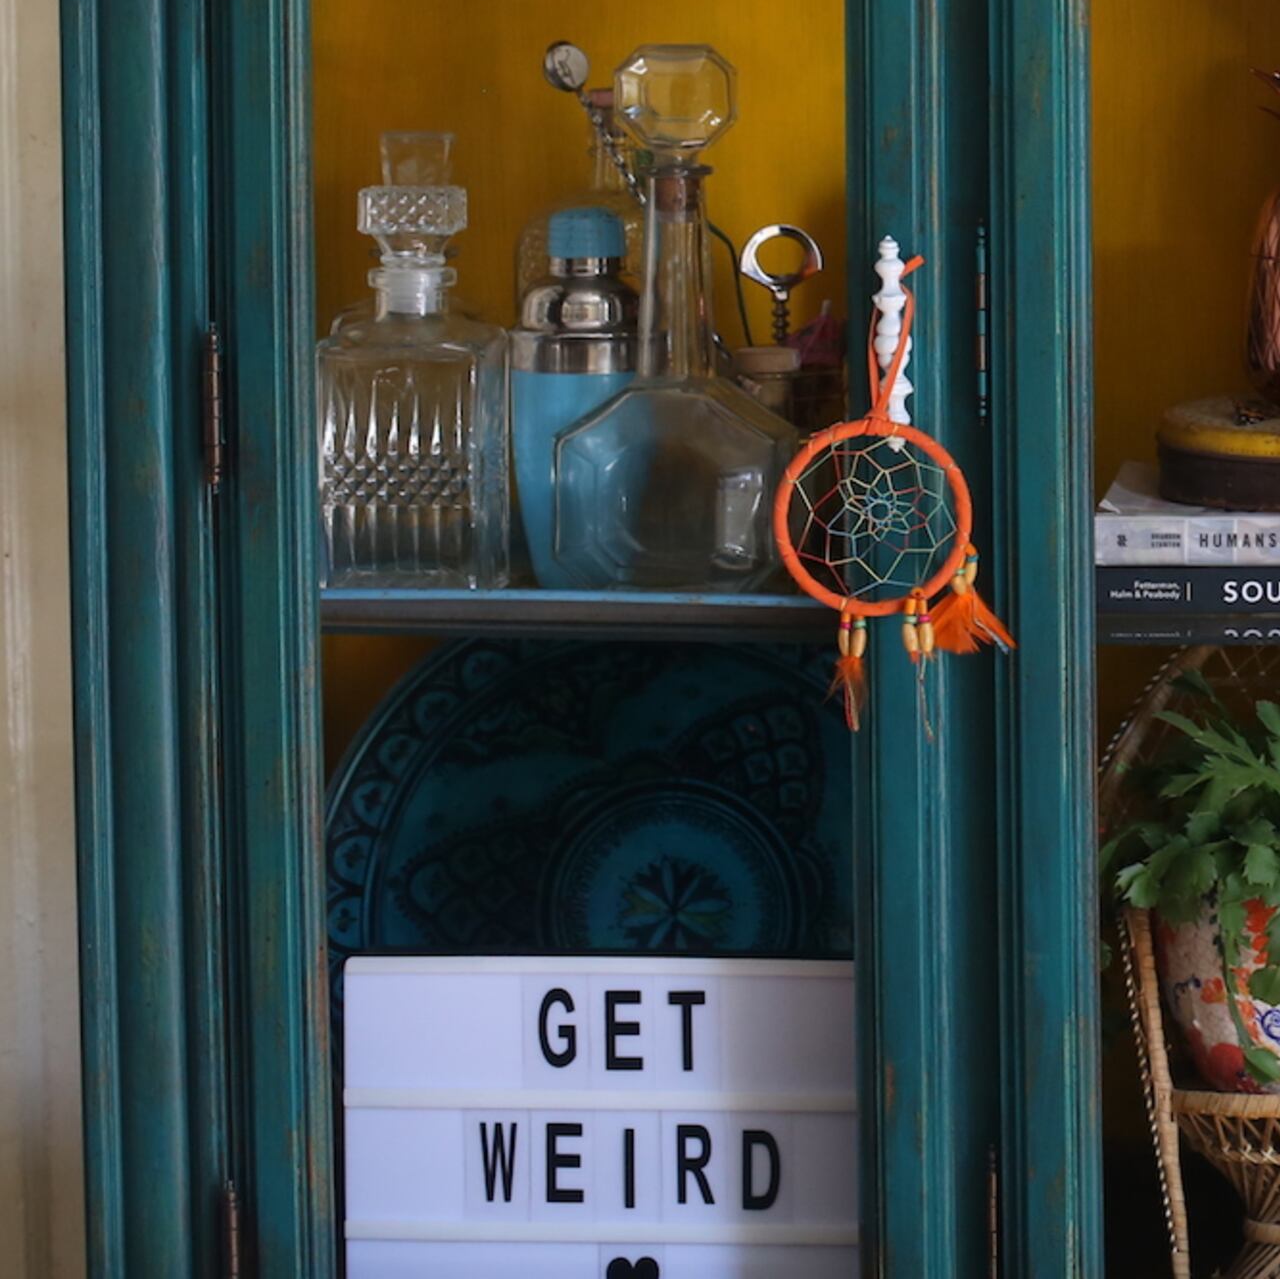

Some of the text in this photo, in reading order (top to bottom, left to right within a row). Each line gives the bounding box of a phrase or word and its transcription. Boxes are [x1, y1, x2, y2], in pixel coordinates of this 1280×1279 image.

[1199, 532, 1278, 548] HUMANS
[1134, 590, 1142, 599] &
[1143, 590, 1181, 601] Peabody
[538, 987, 706, 1072] GET
[479, 1122, 782, 1211] WEIRD
